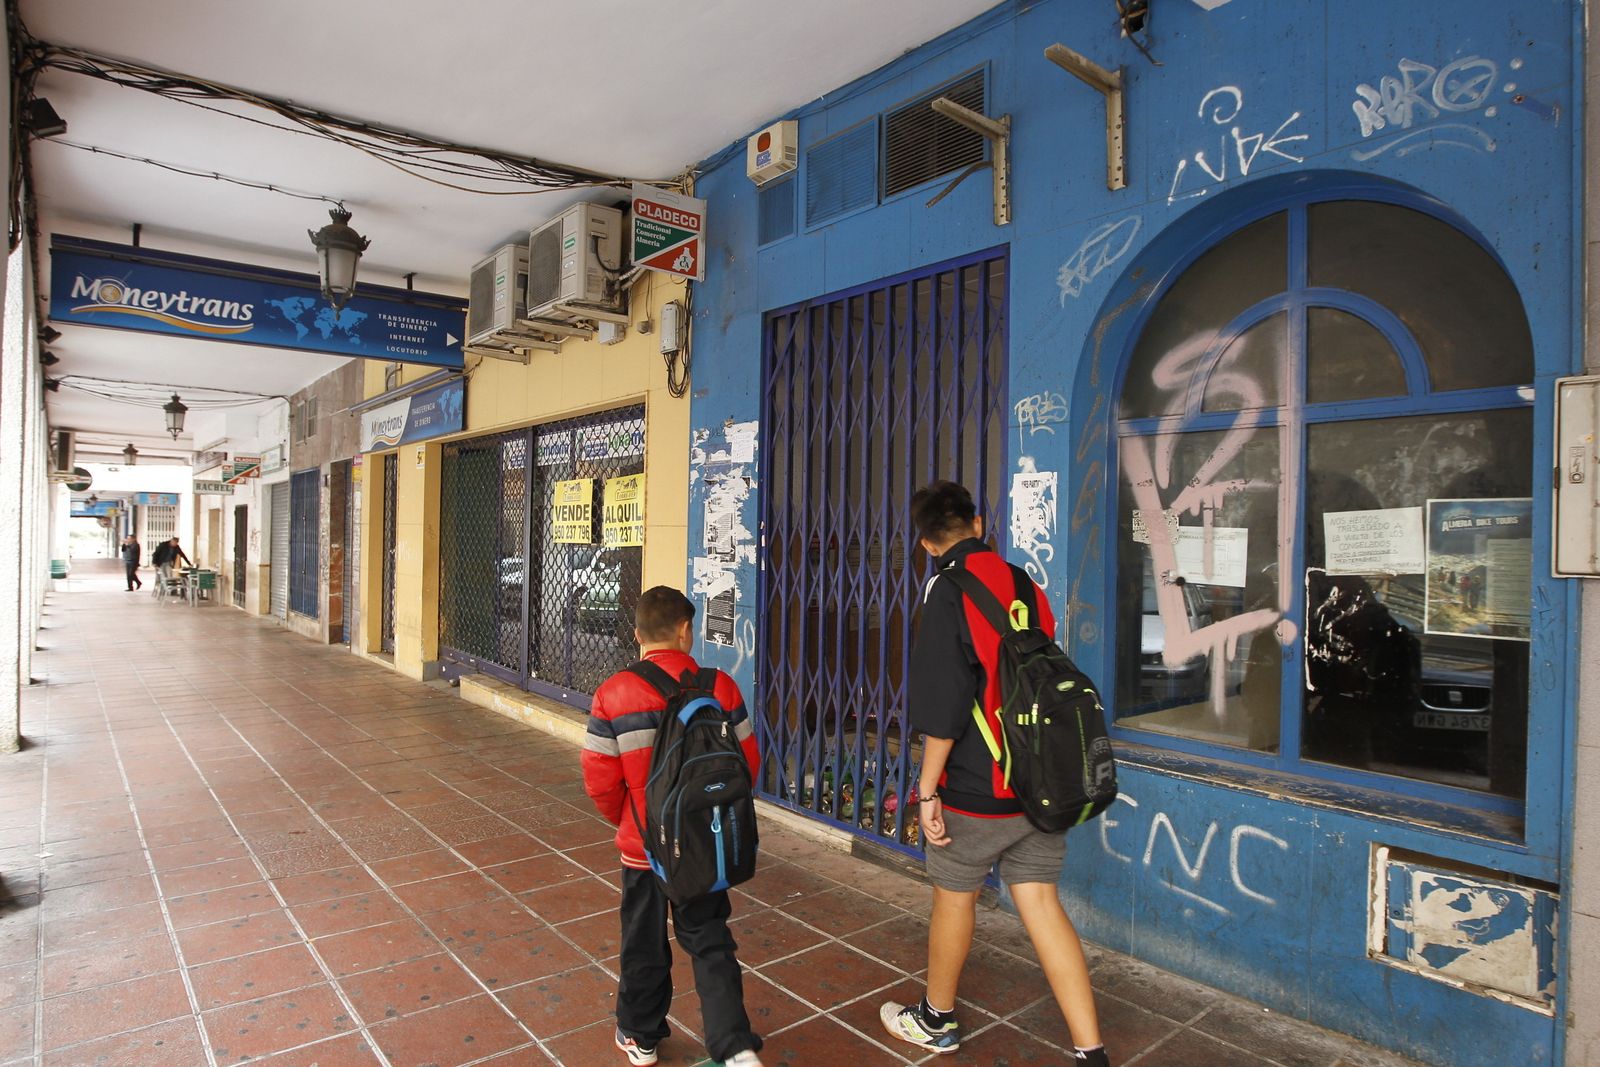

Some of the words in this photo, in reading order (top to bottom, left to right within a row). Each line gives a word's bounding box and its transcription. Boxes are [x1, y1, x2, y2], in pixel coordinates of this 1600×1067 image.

[638, 202, 698, 228] PLADECO
[636, 220, 671, 235] Tradicional
[636, 228, 666, 241] Comercio
[70, 275, 254, 321] Moneytrans
[378, 313, 437, 327] TRANSFERENCIA
[400, 323, 428, 332] DINERO
[390, 333, 425, 343] INTERNET
[386, 345, 428, 356] LOCUTORIO
[555, 503, 590, 522] VENDE
[604, 502, 644, 524] ALQUIL
[565, 525, 577, 540] 237
[578, 525, 590, 541] 796
[605, 527, 618, 543] 950
[619, 526, 633, 542] 237
[635, 525, 644, 542] 79
